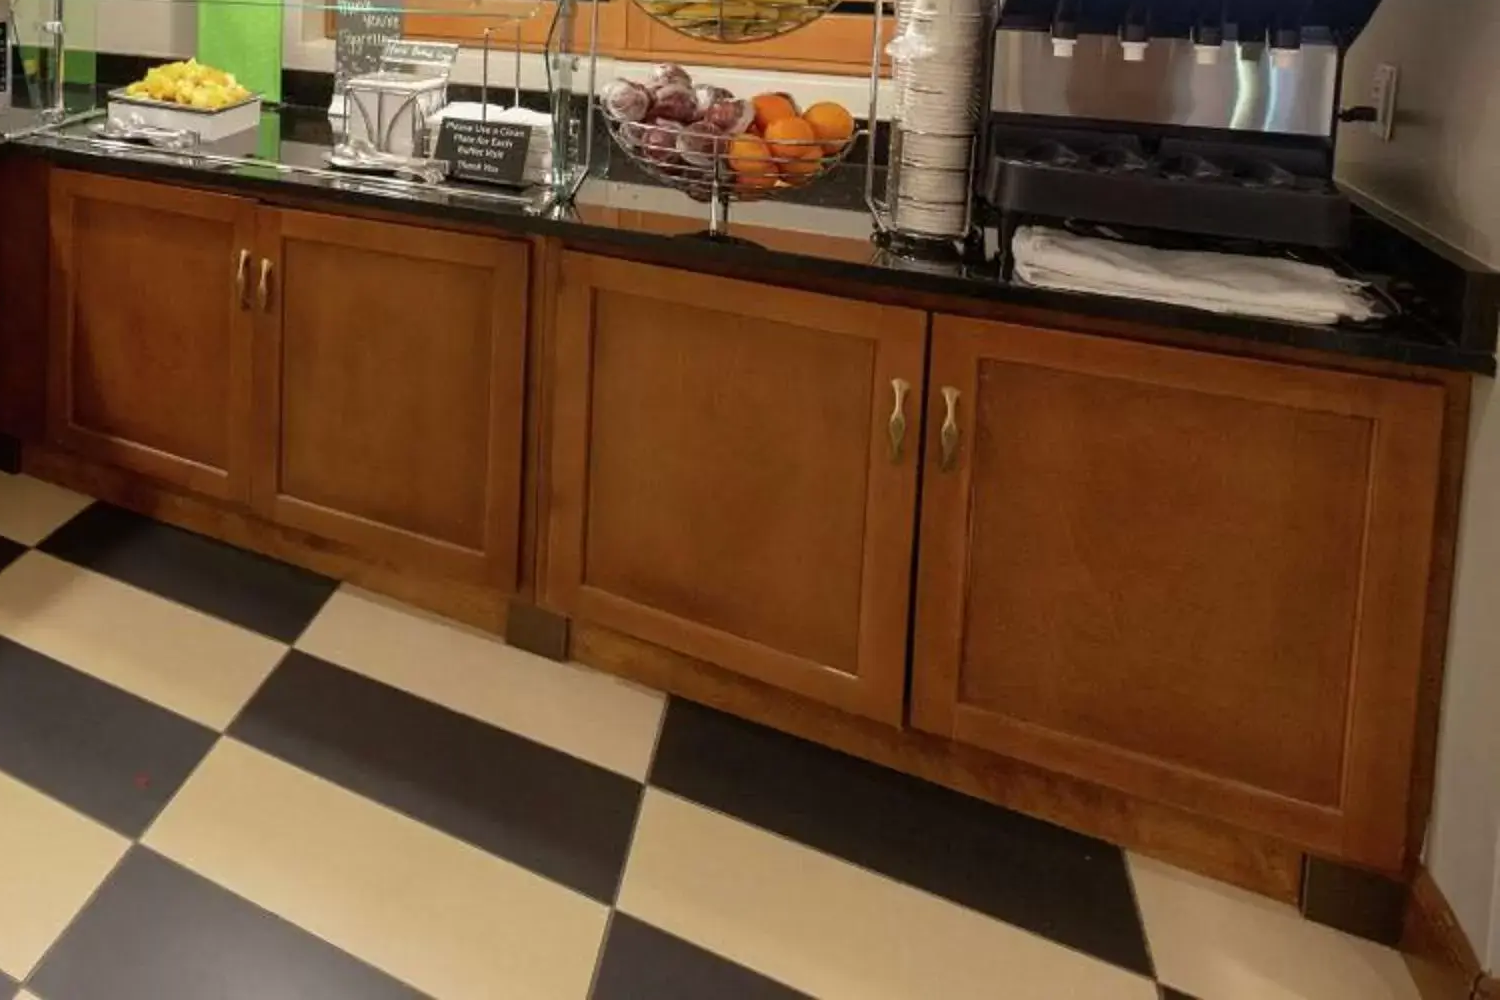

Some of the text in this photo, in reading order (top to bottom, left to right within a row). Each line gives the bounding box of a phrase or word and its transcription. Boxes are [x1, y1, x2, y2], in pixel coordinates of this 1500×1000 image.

[475, 124, 490, 134] Use
[499, 127, 525, 137] Clean
[491, 137, 514, 148] Each
